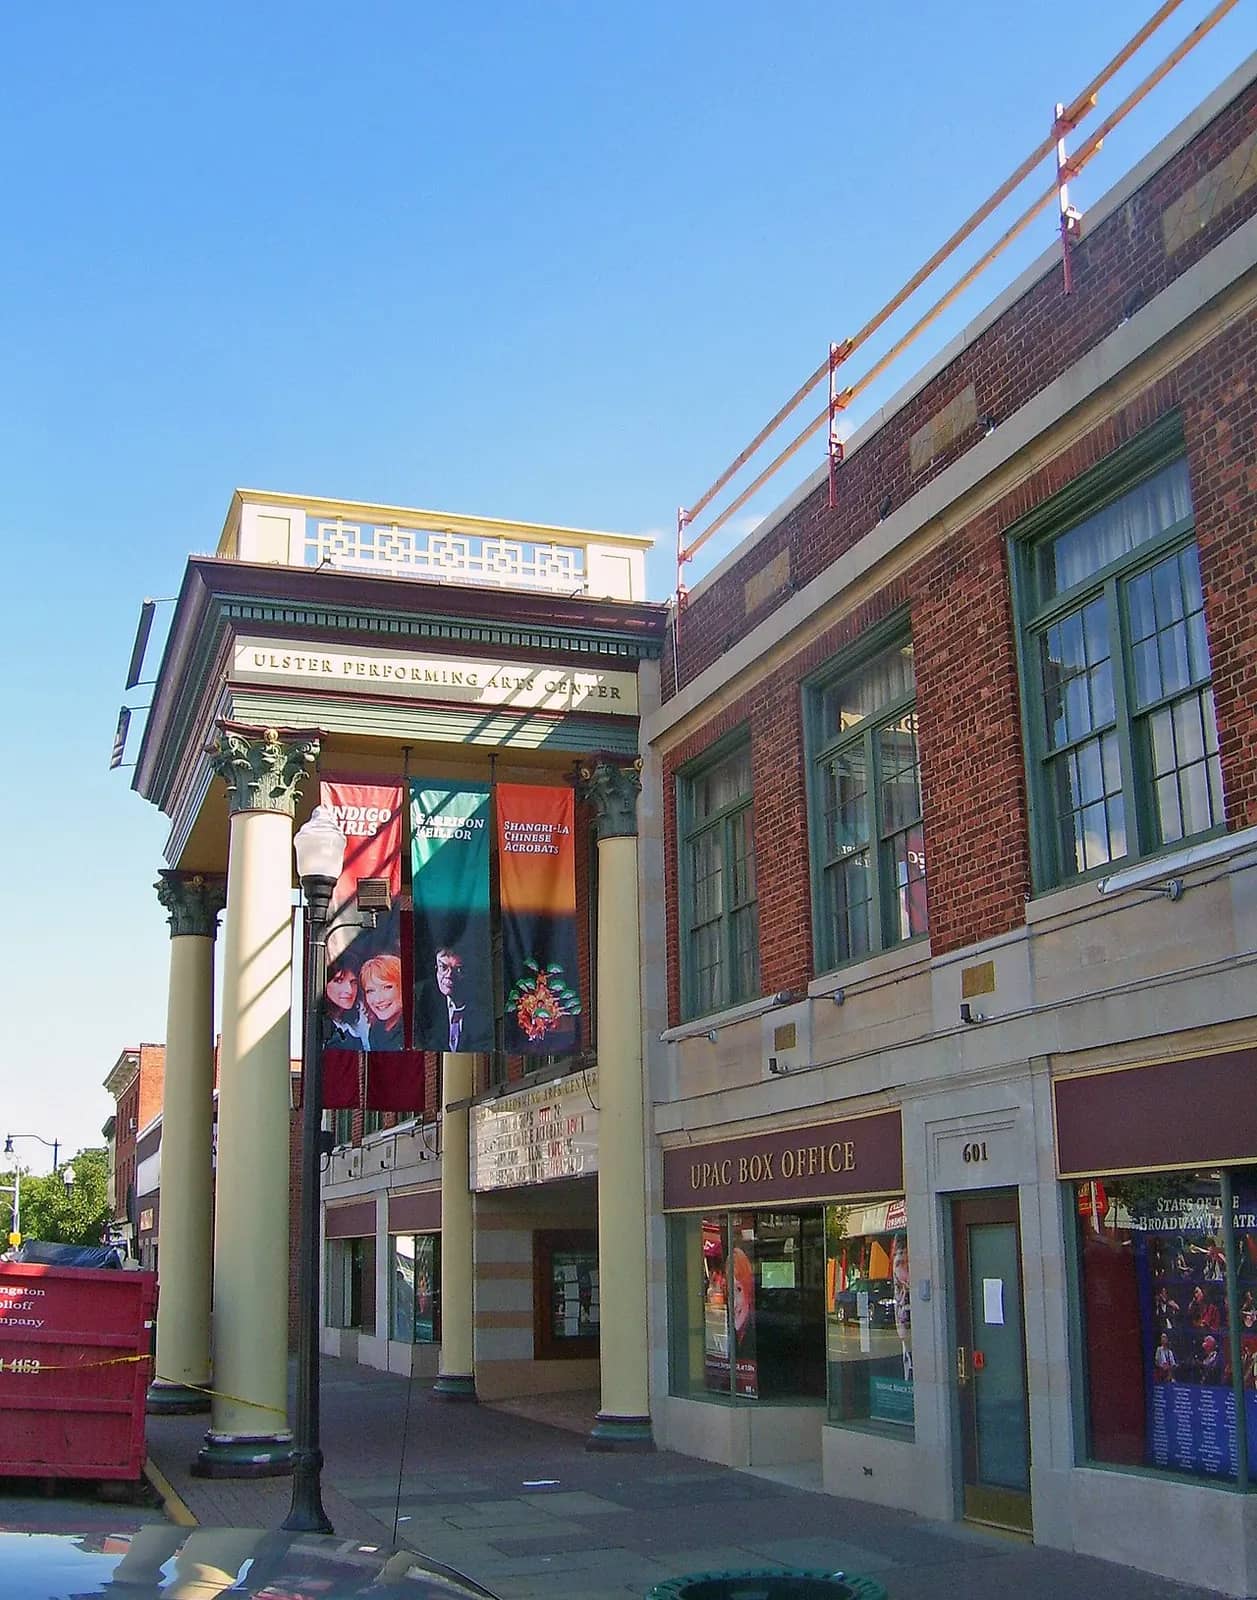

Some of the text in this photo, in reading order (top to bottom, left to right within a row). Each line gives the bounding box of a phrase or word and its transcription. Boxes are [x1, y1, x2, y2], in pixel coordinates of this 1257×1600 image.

[254, 653, 621, 700] ULSTER PERFORMING ARTS CENTER
[336, 820, 377, 836] IRLS
[415, 813, 485, 829] GARRISON
[503, 820, 570, 835] SHANGRI-LA
[415, 825, 472, 841] KEILLOR
[504, 831, 552, 843] CHINESE
[503, 841, 559, 855] ACROBATS
[962, 1141, 989, 1163] 601
[690, 1140, 856, 1190] UPAC BOX OFFICE
[1157, 1197, 1193, 1212] STARS
[1214, 1195, 1240, 1209] TE
[1206, 1213, 1257, 1230] THATR
